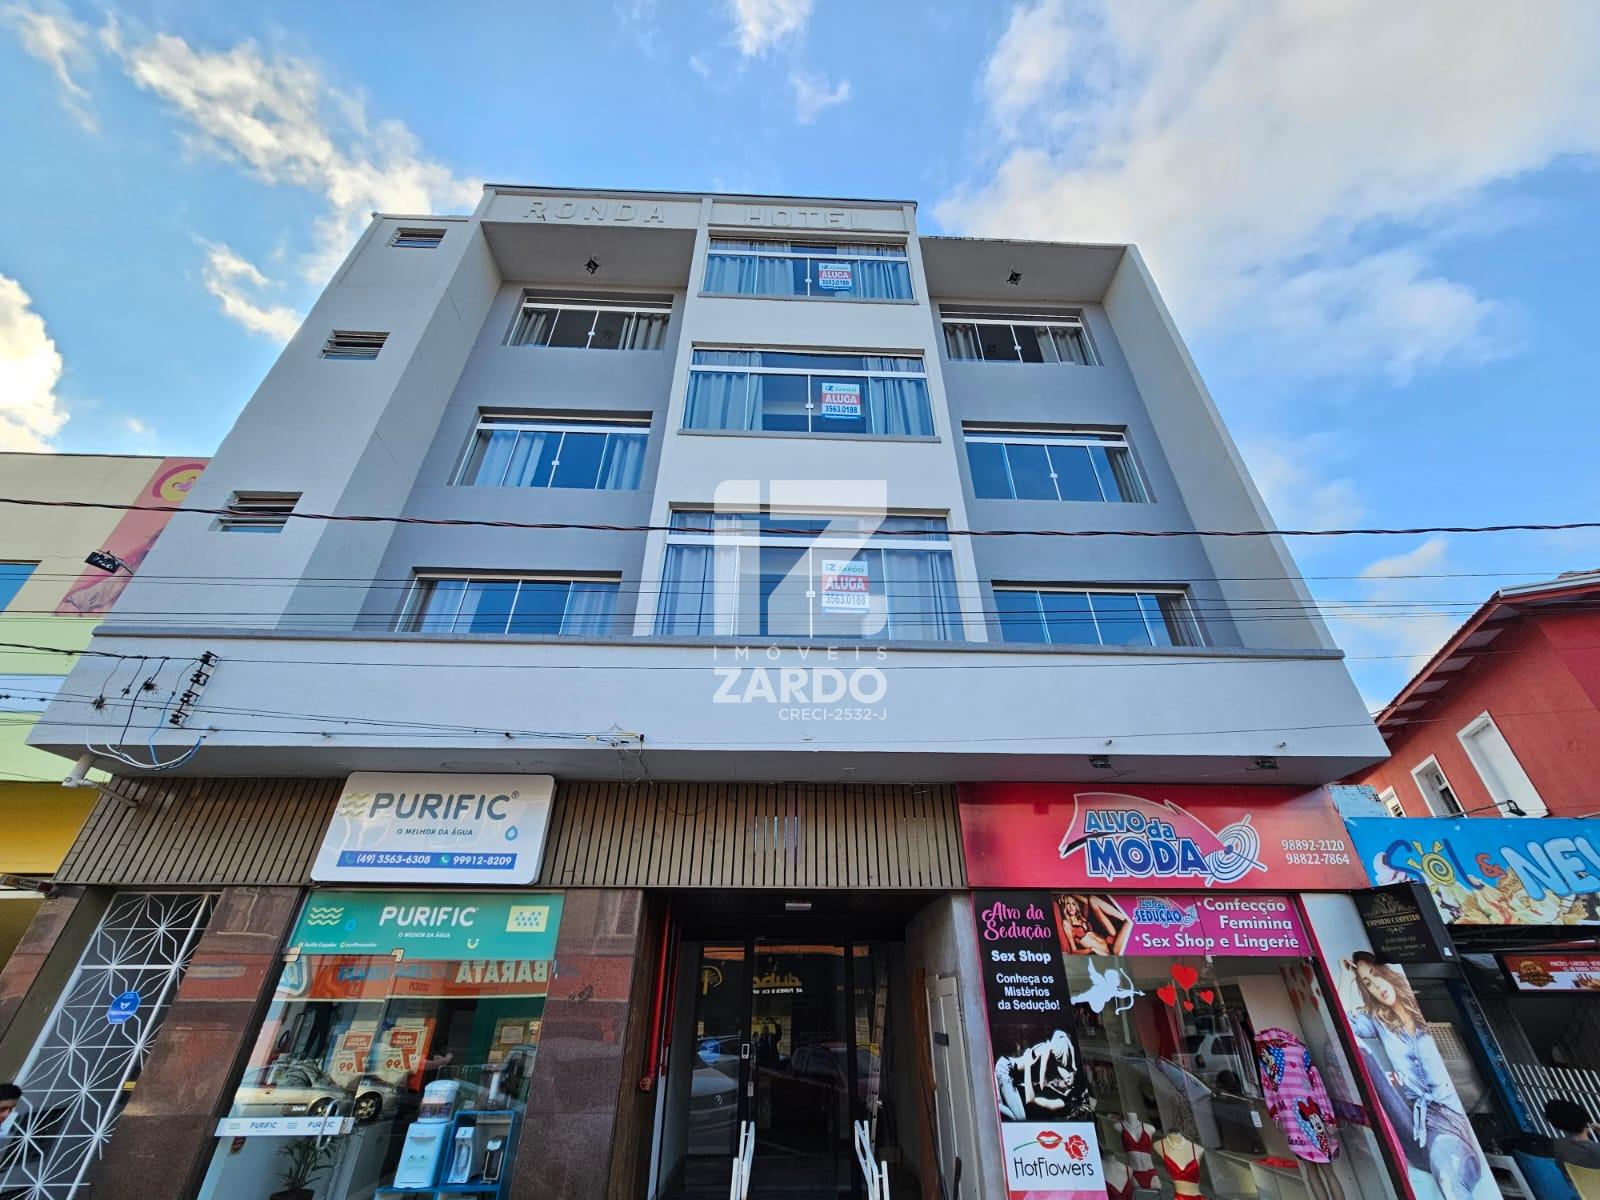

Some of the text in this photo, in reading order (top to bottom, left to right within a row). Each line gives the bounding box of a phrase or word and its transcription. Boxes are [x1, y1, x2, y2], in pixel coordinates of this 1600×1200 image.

[523, 201, 868, 231] RONDA HOTEL
[821, 271, 849, 279] ALUGA
[824, 394, 858, 404] ALUGA
[825, 576, 866, 591] ALUGA
[825, 594, 867, 606] 3563.0188
[368, 792, 511, 821] PURIFIC
[404, 828, 437, 836] MELHOR
[438, 828, 449, 836] DA
[451, 827, 473, 836] ÁGUA
[1084, 810, 1176, 840] ALVO da
[1281, 839, 1345, 852] 98892-2120
[356, 853, 512, 866] (49) 3563-6308 99912-8209
[1086, 838, 1214, 880] MODA
[1286, 852, 1351, 865] 98822-7864
[1474, 852, 1508, 878] &
[981, 901, 1045, 922] Alvo da
[1203, 897, 1286, 914] Confecção
[379, 906, 476, 927] PURIFIC
[1219, 915, 1293, 930] Feminina
[984, 919, 1052, 941] Sedução
[1141, 933, 1300, 951] Sex Shop e Lingerie
[991, 949, 1052, 965] Sex Shop
[996, 973, 1055, 985] Conheça os
[1004, 985, 1050, 997] Mistérios
[997, 999, 1061, 1012] da Sedução!
[249, 1121, 278, 1129] PURIFIC
[307, 1121, 336, 1129] PURIC
[1013, 1156, 1095, 1179] HotFlowers
